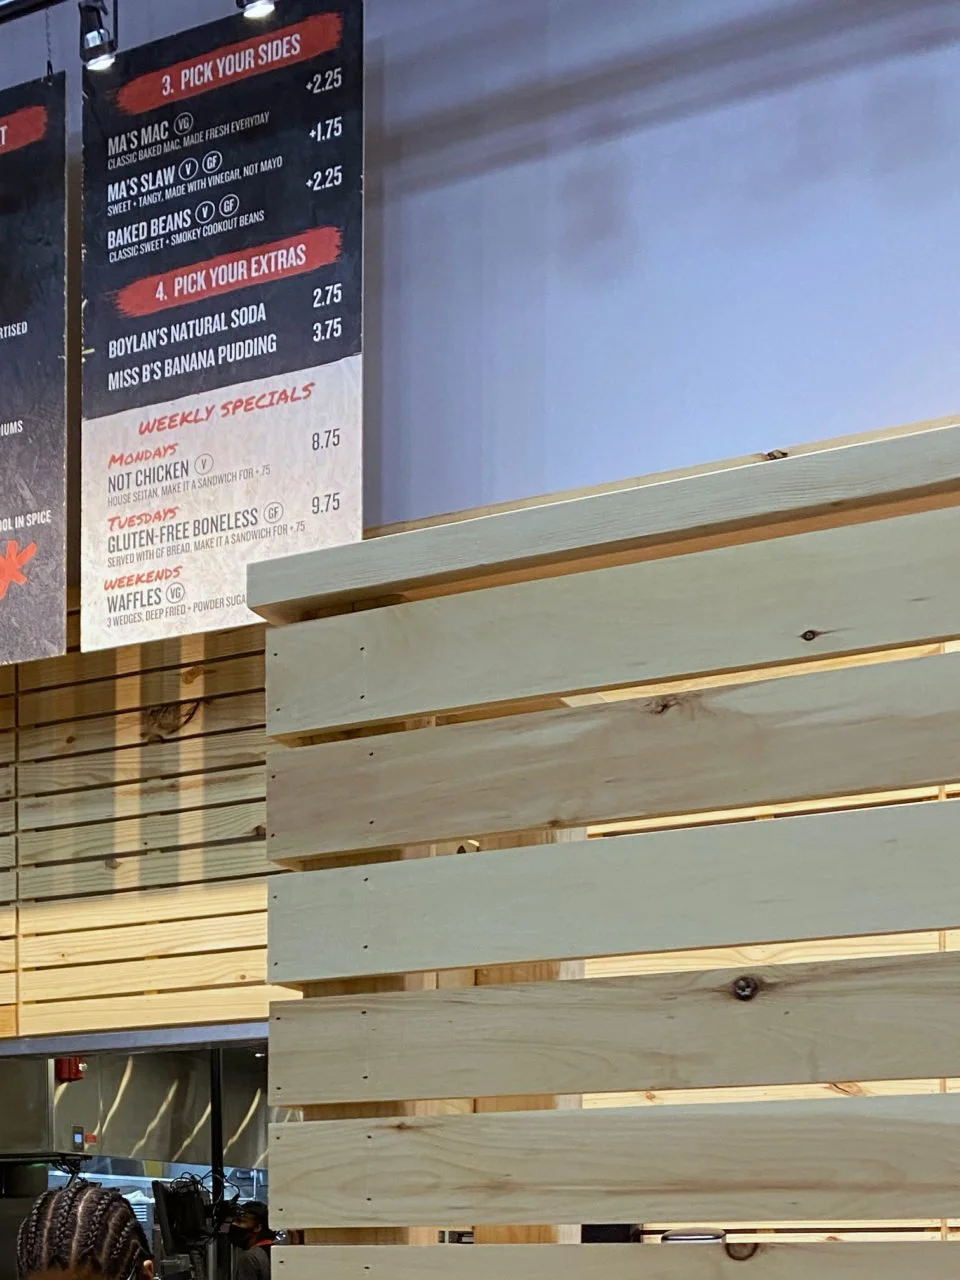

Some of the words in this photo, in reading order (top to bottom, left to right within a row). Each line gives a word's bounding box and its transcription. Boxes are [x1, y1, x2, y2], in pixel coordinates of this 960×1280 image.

[162, 75, 173, 97] 3.
[181, 61, 213, 90] PICK
[216, 48, 254, 79] YOUR
[258, 33, 300, 66] SIDES
[108, 130, 138, 156] MA'S
[141, 120, 169, 146] MAC
[306, 67, 342, 97] +2.25
[108, 176, 138, 202] MA'S
[140, 165, 175, 193] SLAW
[309, 116, 342, 144] +1.75
[108, 200, 131, 217] SWEET
[165, 184, 186, 200] MADE
[187, 178, 206, 194] WITH
[243, 163, 258, 177] NOT
[260, 155, 283, 172] MAYO
[108, 221, 147, 249] BAKED
[150, 208, 191, 237] BEANS
[306, 166, 342, 194] +2.25
[109, 246, 138, 263] CLASSIC
[140, 238, 164, 255] SWEET
[171, 228, 201, 246] SMOKEY
[202, 217, 238, 237] COOKOUT
[239, 210, 264, 227] BEANS
[156, 281, 167, 303] 4.
[174, 270, 206, 298] PICK
[210, 259, 248, 288] YOUR
[251, 243, 306, 278] EXTRAS
[109, 327, 168, 360] BOYLAN'S
[171, 311, 228, 344] NATURAL
[231, 301, 266, 328] SODA
[313, 283, 342, 308] 2.75
[108, 366, 139, 392] MISS
[142, 361, 161, 383] B'S
[164, 347, 215, 378] BANANA
[218, 332, 277, 365] PUDDING
[313, 317, 342, 342] 3.75
[139, 404, 215, 437] WEEKLY
[220, 381, 316, 419] SPECIALS
[108, 440, 179, 470] MONDAYS
[108, 472, 132, 494] NOT
[135, 459, 189, 488] CHICKEN
[312, 428, 340, 452] 8.75
[108, 493, 131, 508] HOUSE
[161, 483, 181, 496] MAKE
[183, 481, 189, 492] IT
[191, 480, 196, 490] A
[197, 471, 237, 489] SANDWICH
[239, 468, 253, 480] FOR
[108, 503, 180, 532] TUESDAYS
[15, 515, 24, 529] IN
[26, 510, 51, 527] SPICE
[108, 521, 189, 555] GLUTEN-FREE
[193, 507, 258, 538] BONELESS
[312, 492, 340, 515] 9.75
[104, 565, 183, 591] WEEKENDS
[107, 587, 161, 614] WAFFLES
[107, 618, 111, 627] 3
[146, 608, 163, 621] DEEP
[165, 605, 185, 617] FRIED
[193, 598, 224, 612] POWDER
[226, 594, 246, 607] SUGA
